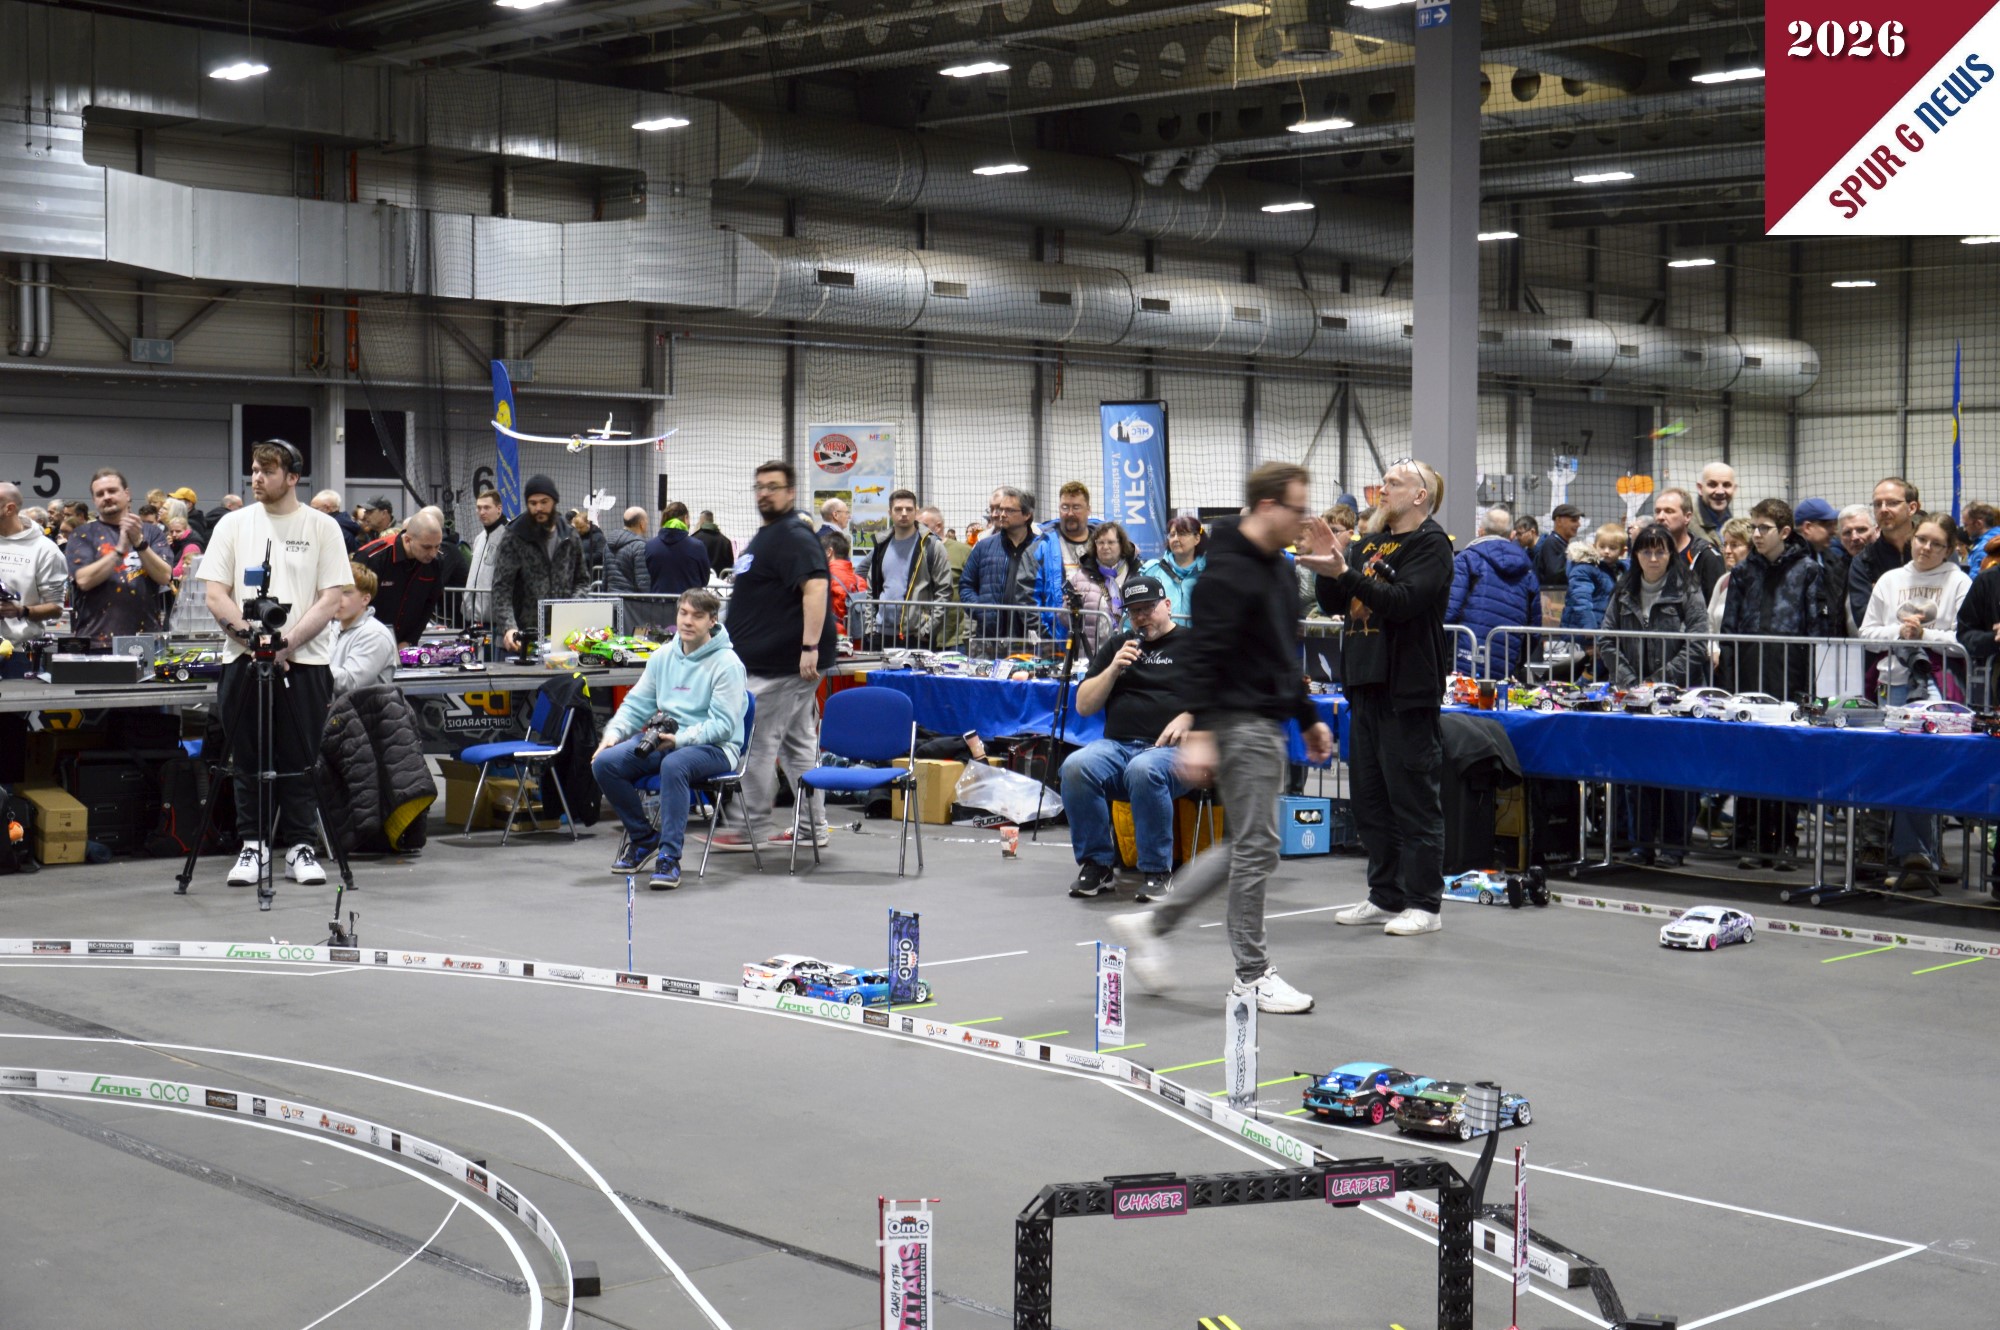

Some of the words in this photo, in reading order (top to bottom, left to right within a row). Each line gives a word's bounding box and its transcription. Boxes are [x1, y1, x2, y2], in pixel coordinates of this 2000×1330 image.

[1581, 430, 1594, 456] 7
[33, 455, 61, 498] 5
[225, 944, 271, 959] Gens
[279, 947, 315, 960] ace
[775, 995, 814, 1015] Gens
[819, 1002, 850, 1020] ace
[90, 1076, 142, 1097] Gens
[149, 1082, 190, 1102] ace
[1240, 1119, 1271, 1147] Gens
[1276, 1135, 1302, 1161] ace
[1332, 1175, 1390, 1197] LEADER
[1119, 1191, 1183, 1212] CHASER
[887, 1219, 930, 1234] OmG
[892, 1263, 900, 1278] THE
[892, 1278, 900, 1291] OF
[890, 1292, 900, 1318] CLASH
